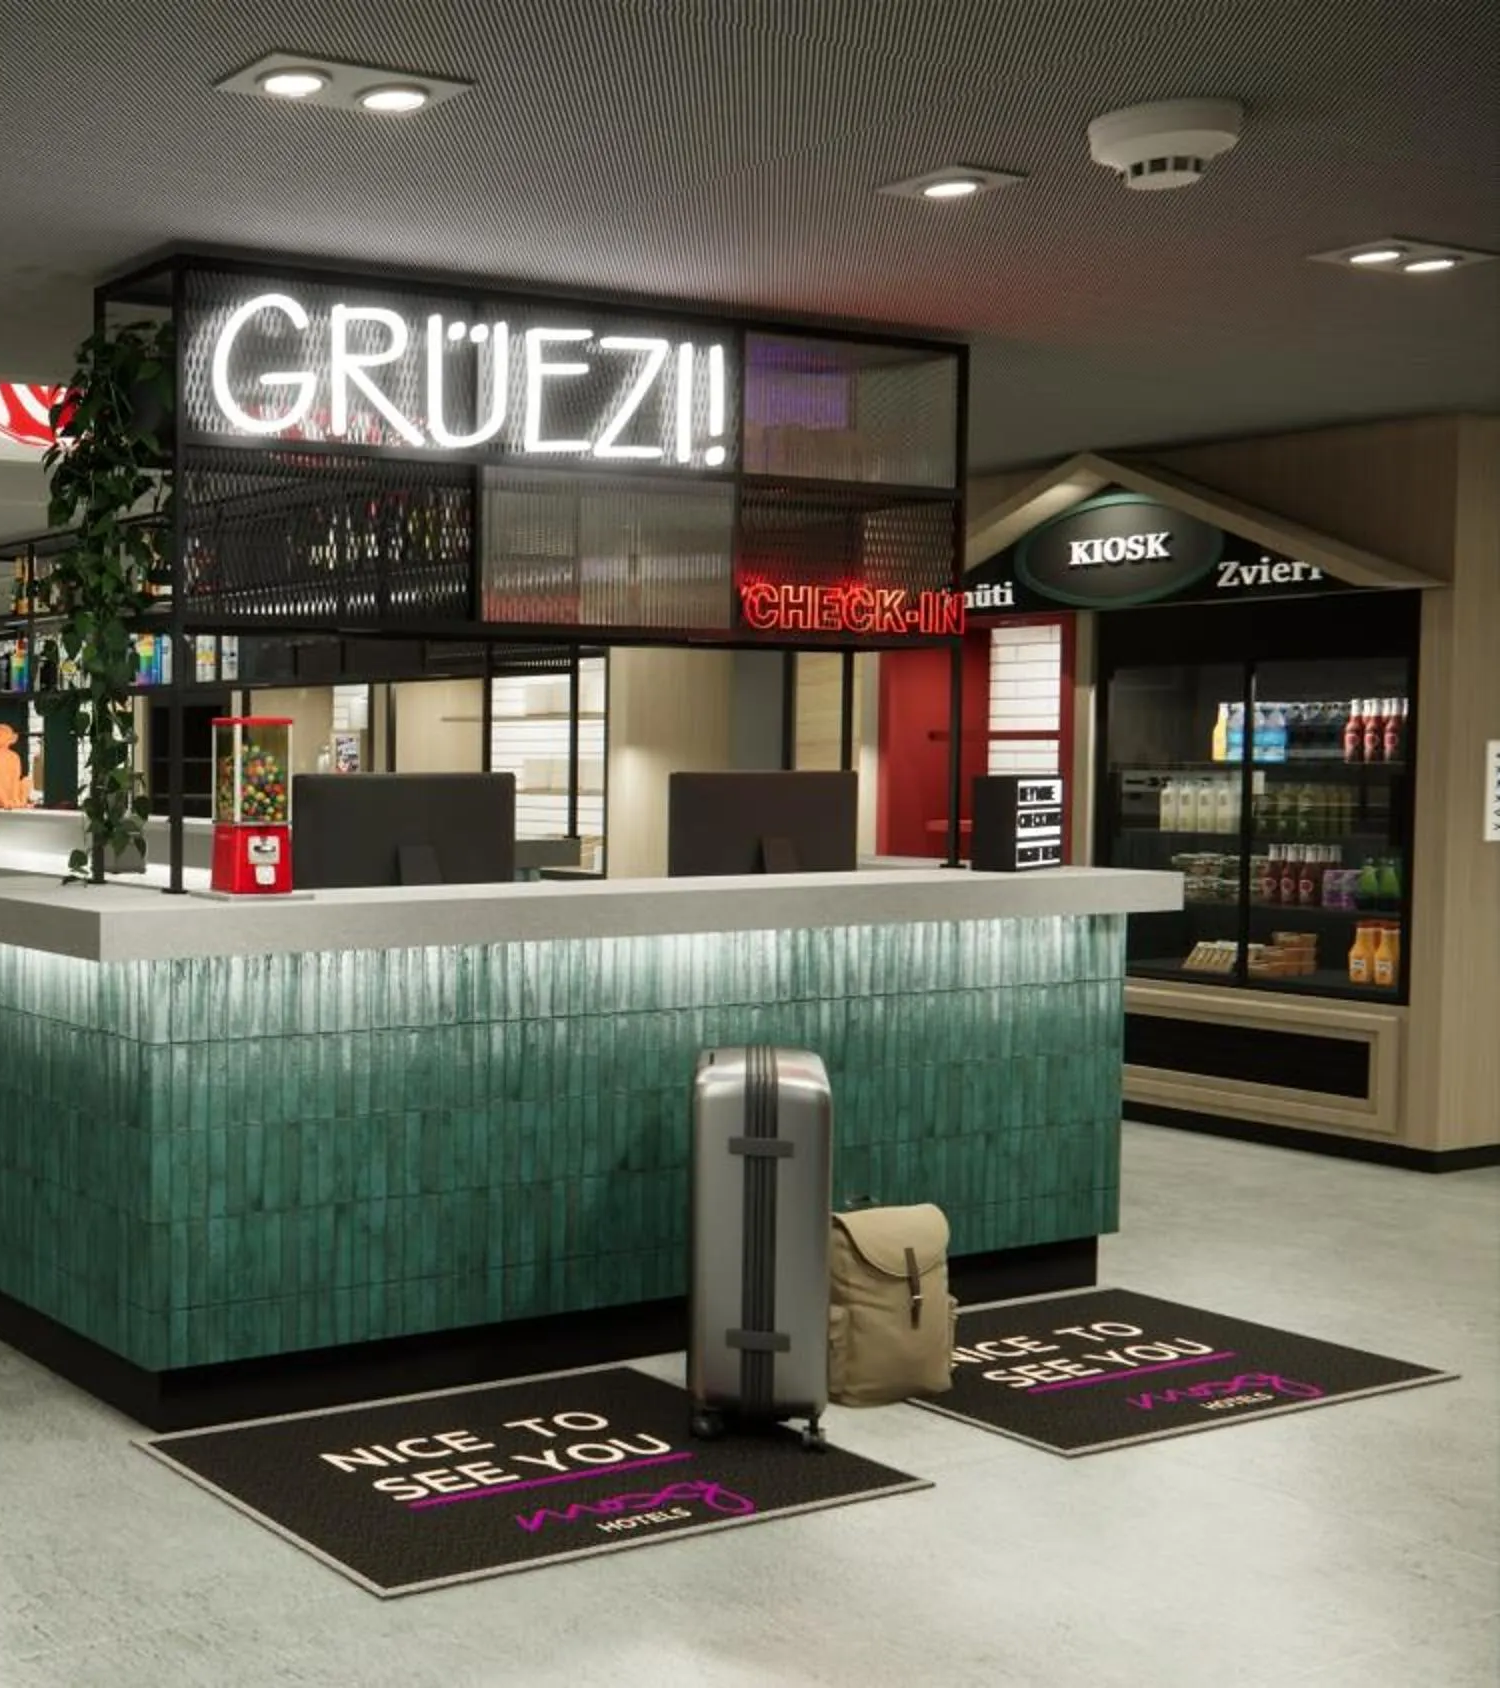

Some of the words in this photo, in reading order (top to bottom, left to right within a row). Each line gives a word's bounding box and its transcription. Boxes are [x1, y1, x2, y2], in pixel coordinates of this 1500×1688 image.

[212, 293, 725, 466] GRÜEZI!
[1068, 532, 1171, 566] KIOSK
[744, 582, 965, 635] CHECK-IN
[1053, 1321, 1144, 1342] TO
[982, 1357, 1105, 1389] SEE
[1097, 1337, 1214, 1368] YOU
[318, 1429, 497, 1474] NICE
[502, 1411, 609, 1439] TO
[372, 1461, 520, 1502] SEE
[511, 1433, 672, 1473] YOU
[596, 1506, 693, 1535] HOTELS
